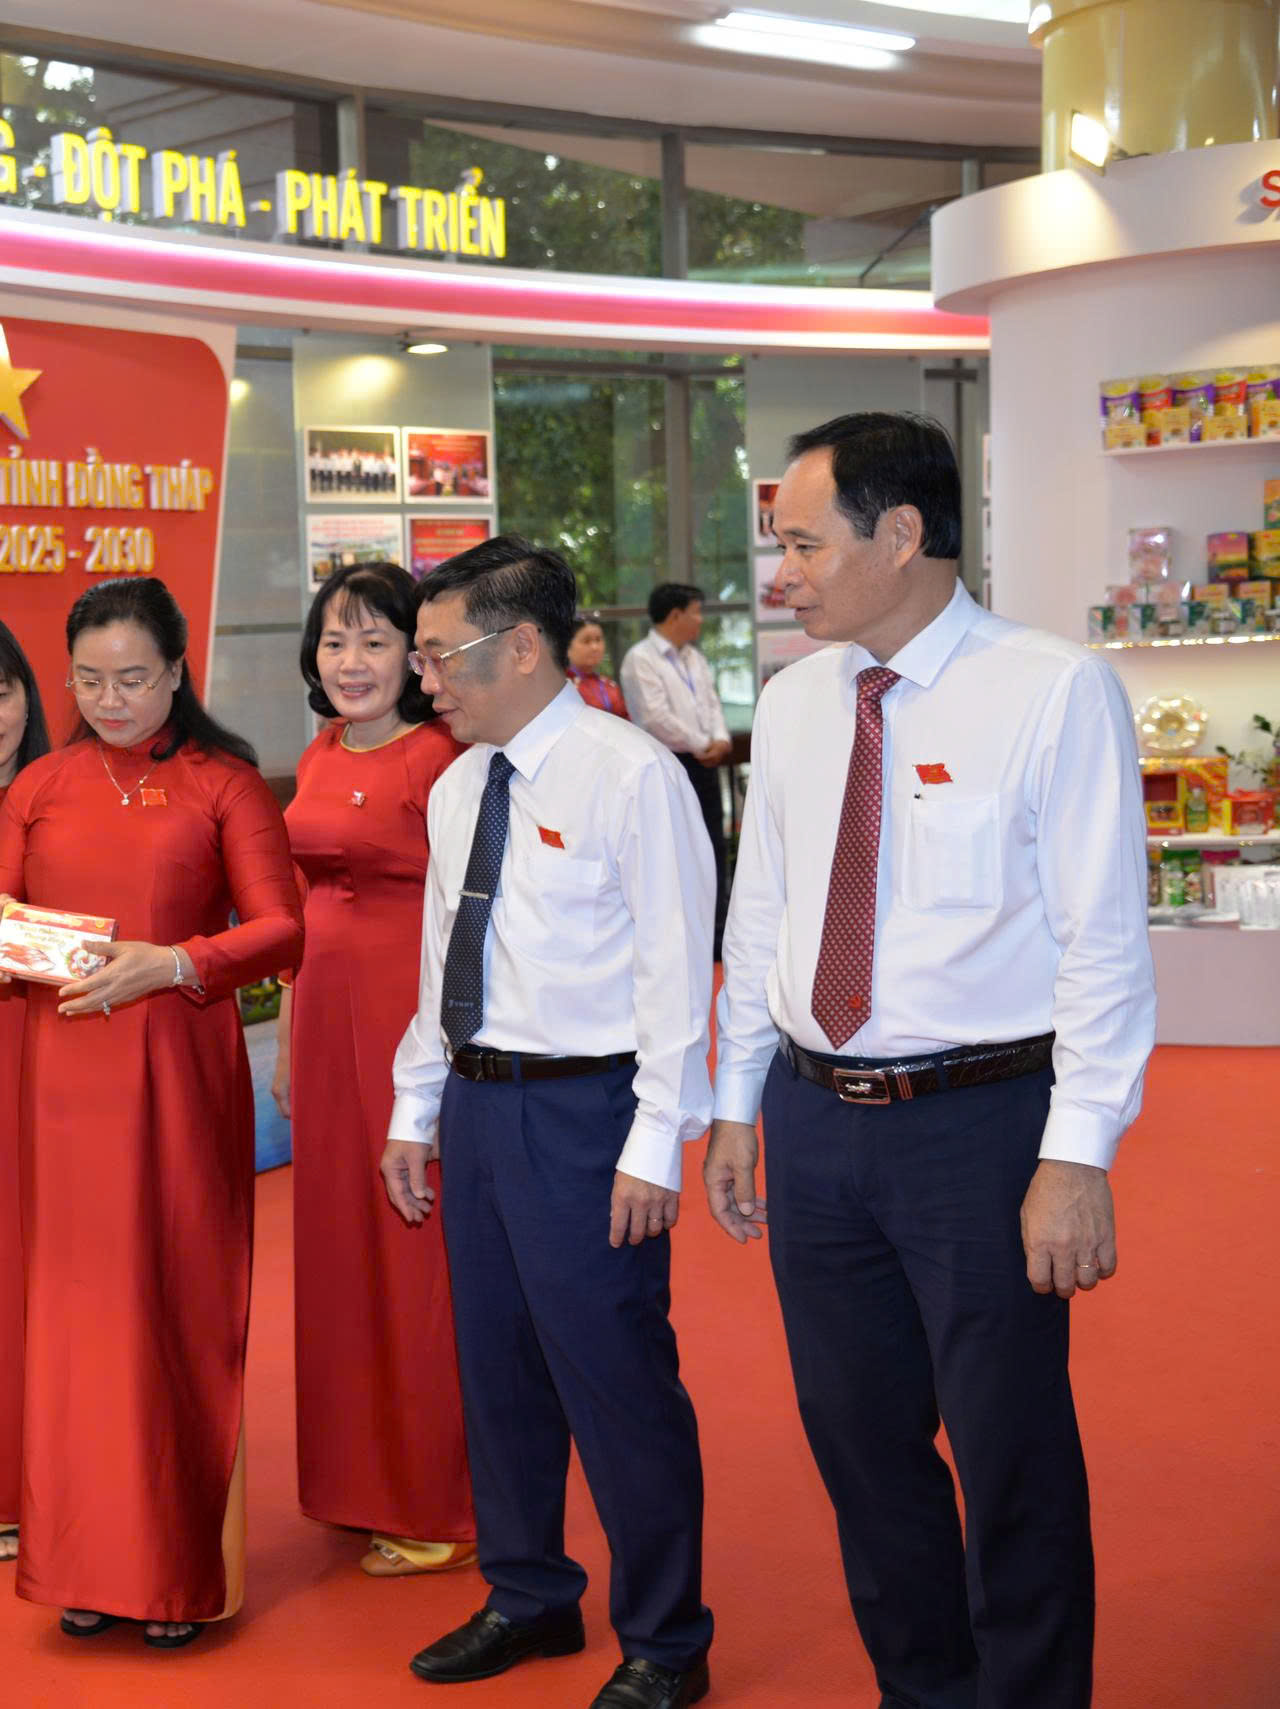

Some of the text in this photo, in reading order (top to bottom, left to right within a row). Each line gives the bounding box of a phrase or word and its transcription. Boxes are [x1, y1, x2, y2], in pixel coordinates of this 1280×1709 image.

[59, 126, 147, 222] ĐỘT
[161, 149, 246, 228] PHÁ
[283, 167, 388, 244] PHÁT
[397, 166, 506, 259] TRIỂN
[67, 446, 144, 509] ĐỒNG
[145, 459, 214, 511] THÁP
[84, 525, 155, 573] 2030
